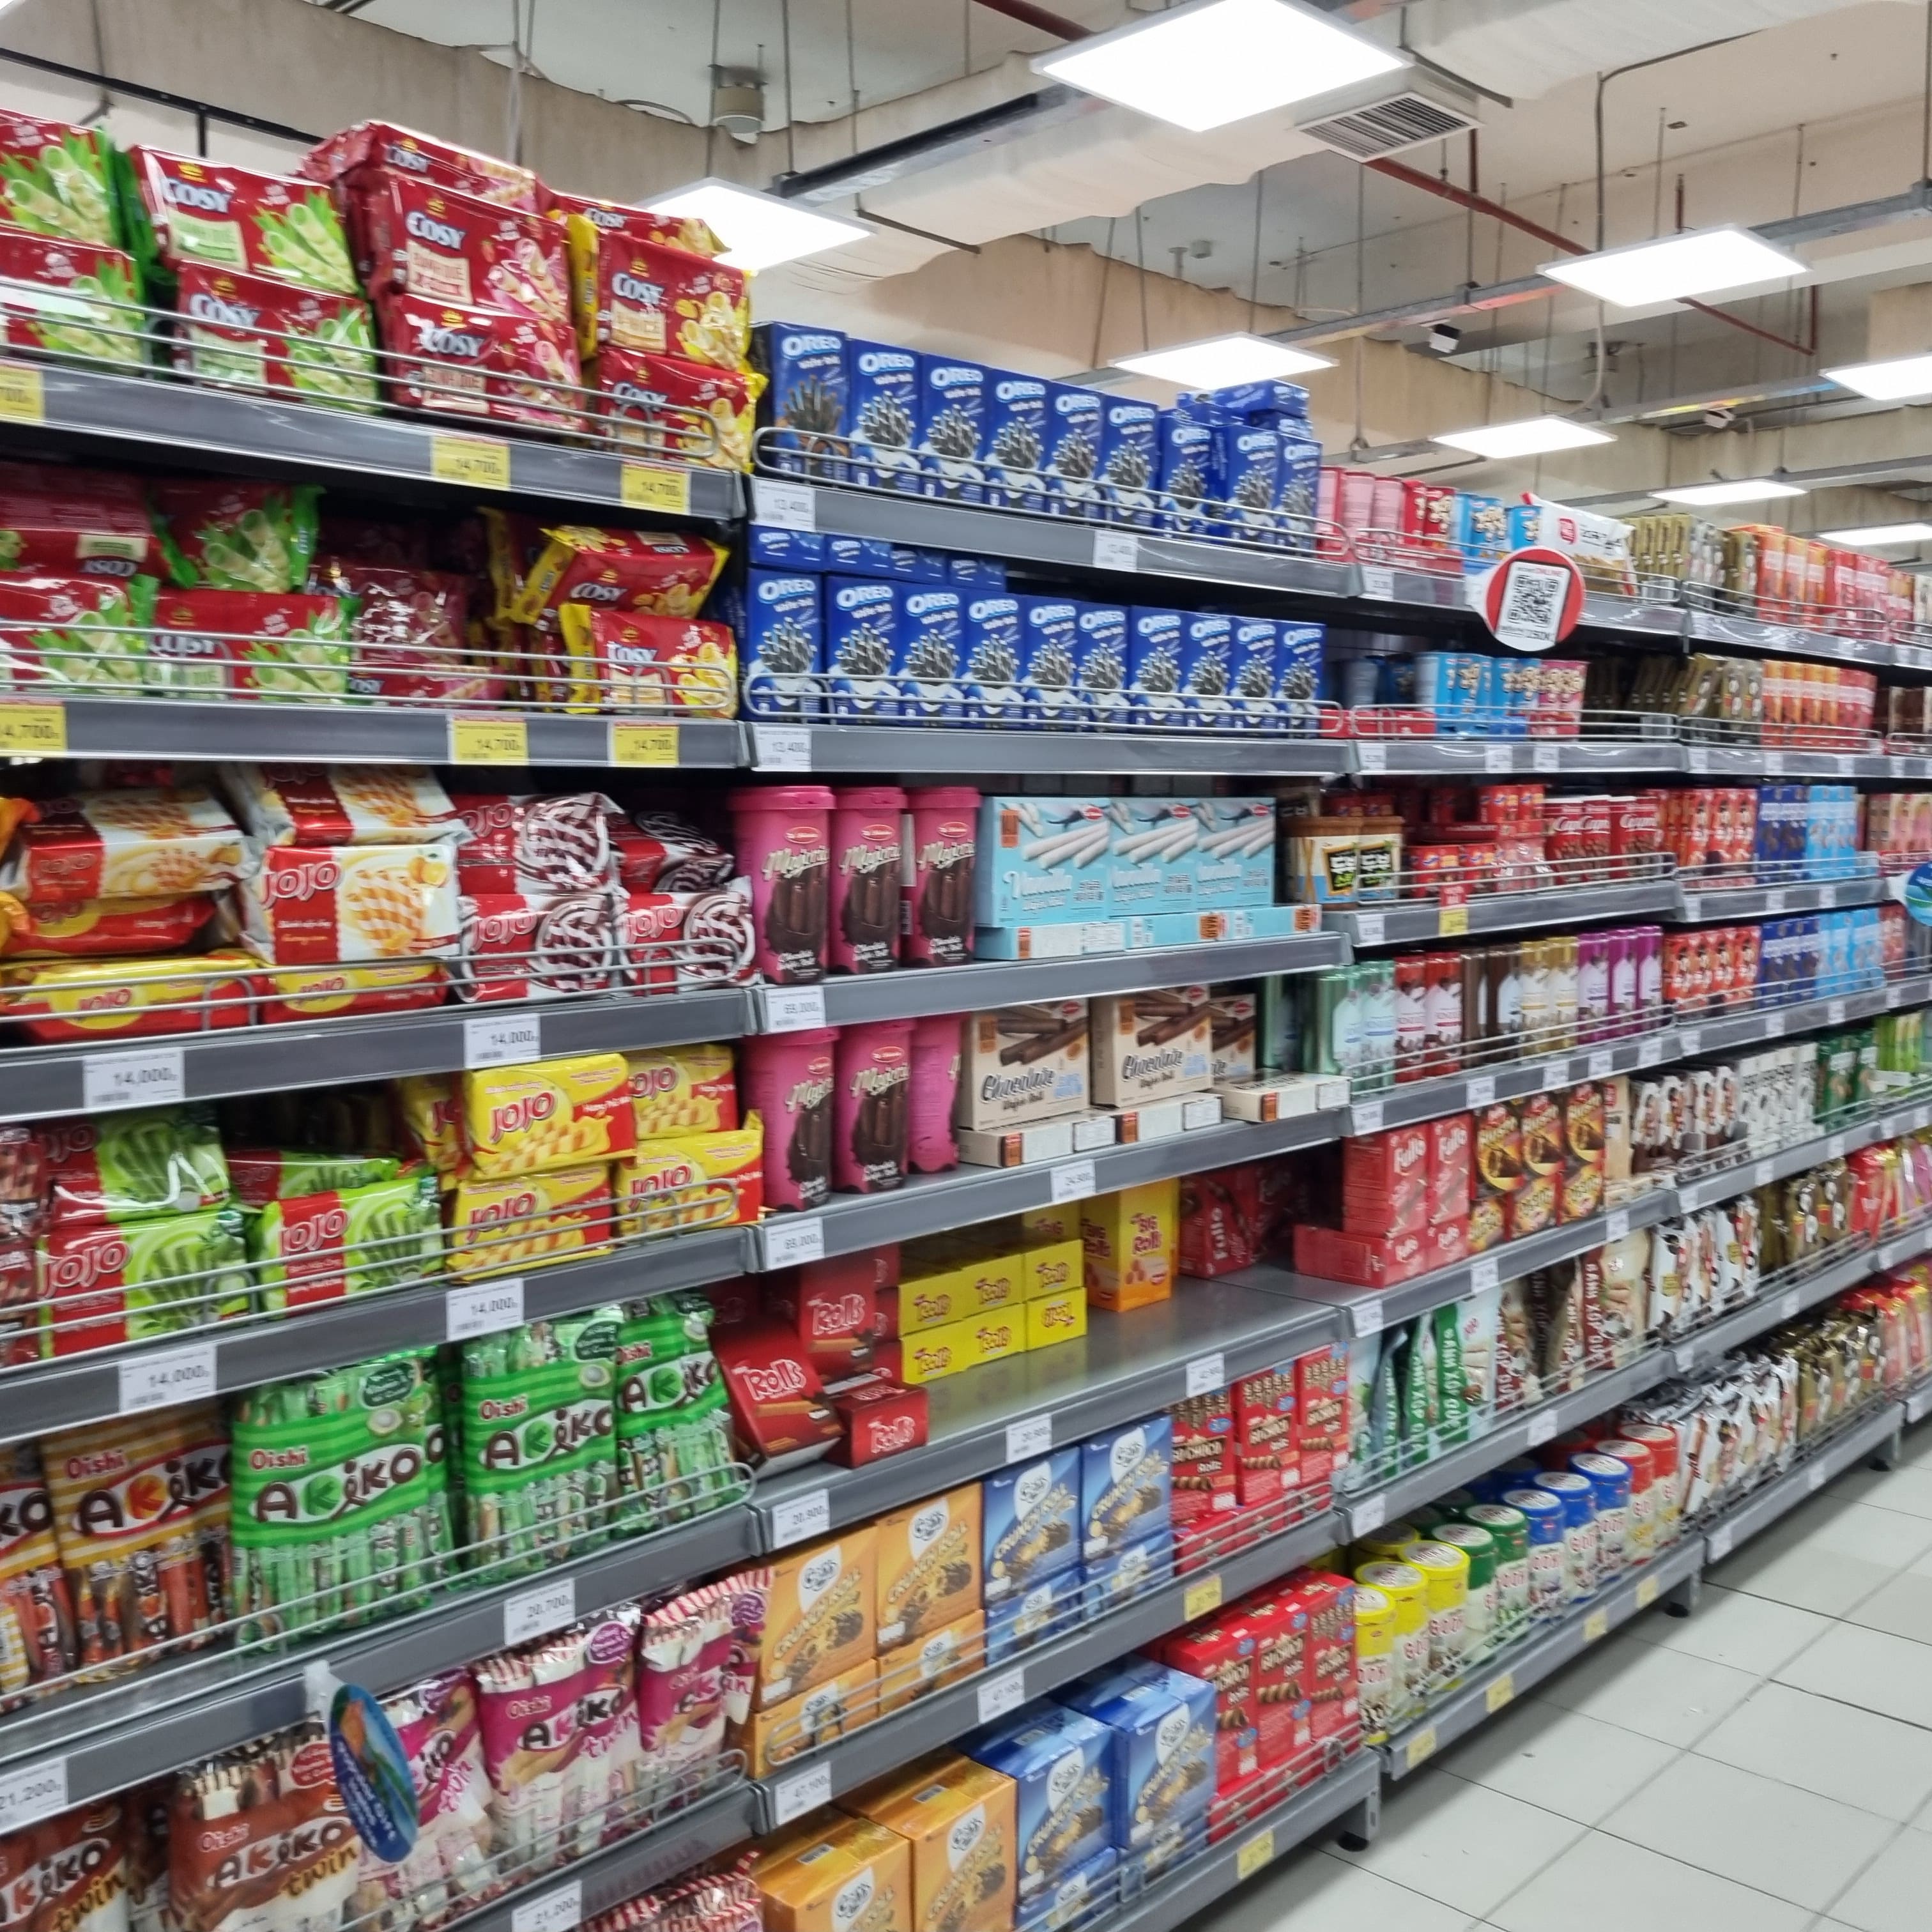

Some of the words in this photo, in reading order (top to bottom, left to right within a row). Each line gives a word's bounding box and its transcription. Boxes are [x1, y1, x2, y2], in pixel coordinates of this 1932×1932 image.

[782, 335, 841, 358] OREO
[859, 353, 914, 374] OREO
[930, 367, 983, 389] OREO
[997, 382, 1045, 402] OREO
[1056, 395, 1100, 414] OREO
[1110, 406, 1154, 425] OREO
[758, 579, 816, 602] OREO
[836, 585, 893, 610] OREO
[907, 594, 958, 616] OREO
[969, 599, 1018, 622] OREO
[1030, 605, 1076, 627] OREO
[1080, 610, 1125, 632] OREO
[1138, 615, 1181, 636] OREO
[742, 1358, 806, 1400] Rolls
[479, 1395, 527, 1422] Oishi
[250, 1446, 308, 1471] Oishi
[285, 1844, 356, 1897] twin
